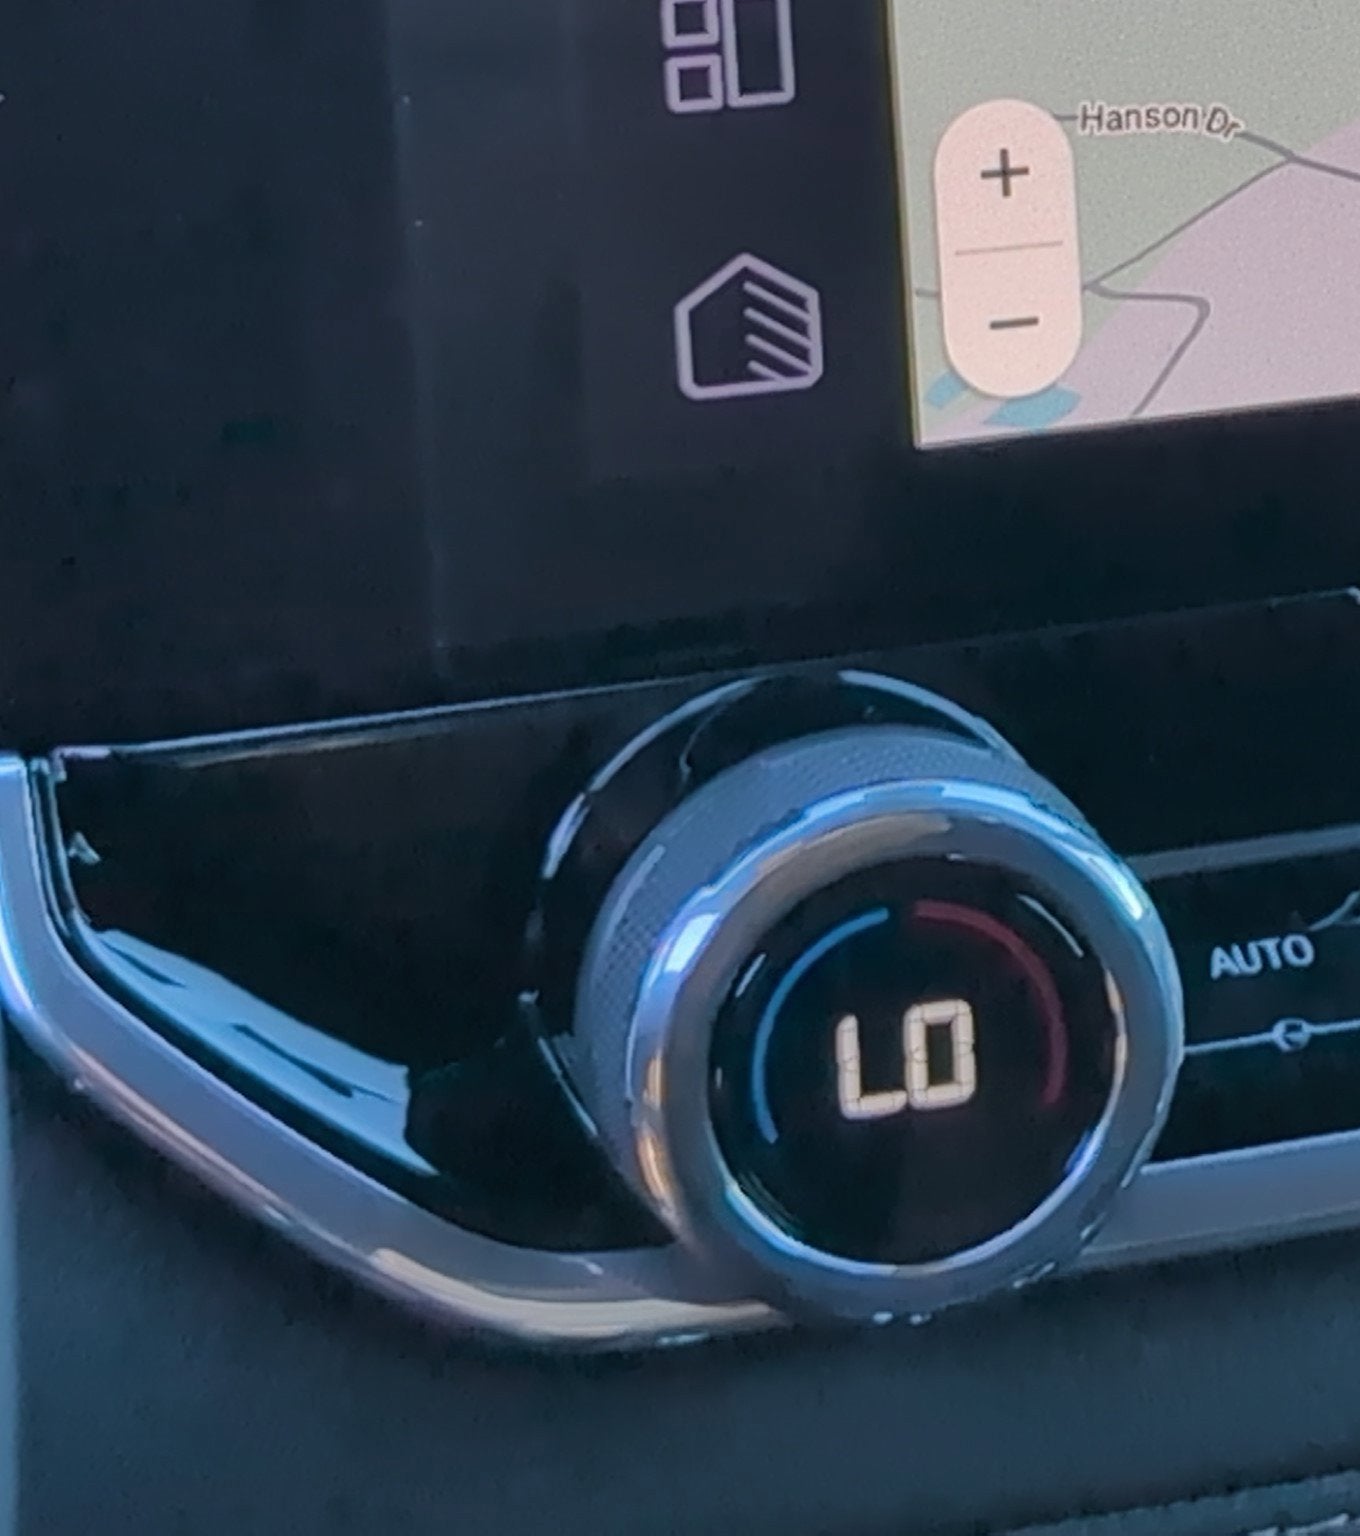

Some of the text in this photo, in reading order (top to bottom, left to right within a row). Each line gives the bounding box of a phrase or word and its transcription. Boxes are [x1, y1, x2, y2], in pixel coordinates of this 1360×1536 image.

[1080, 103, 1241, 138] Hanson Dr
[1210, 935, 1315, 979] AUTO
[835, 997, 977, 1121] LO
